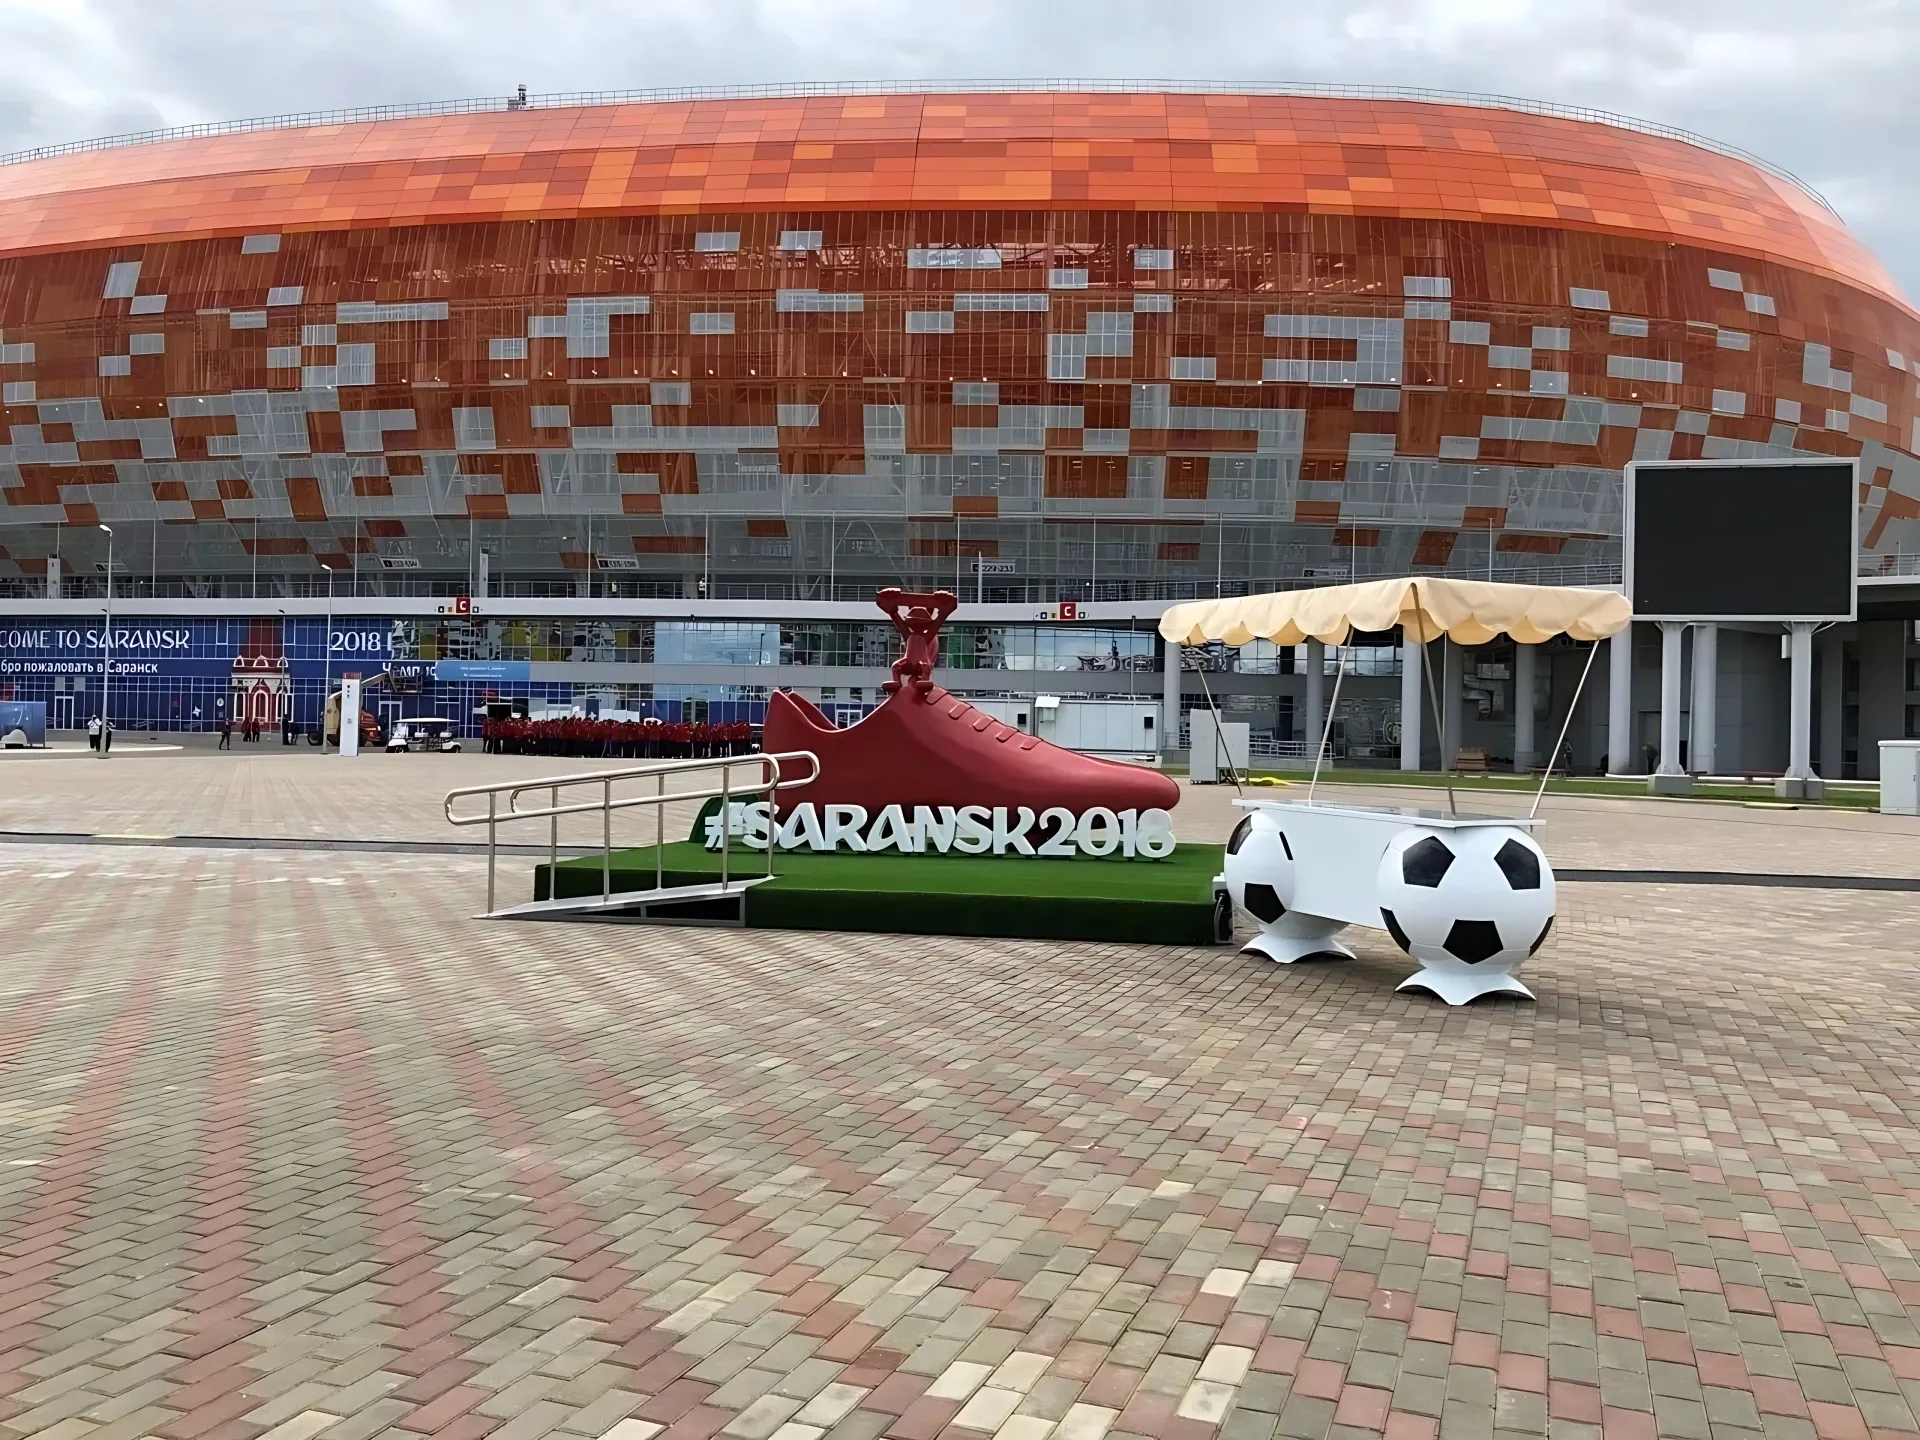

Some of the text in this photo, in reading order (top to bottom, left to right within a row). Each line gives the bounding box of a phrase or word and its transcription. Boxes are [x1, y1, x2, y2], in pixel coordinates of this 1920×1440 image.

[56, 629, 81, 649] TO
[86, 629, 190, 649] SARANSK
[329, 631, 381, 651] 2018
[24, 662, 94, 674] пожаловать
[107, 660, 158, 676] Саранск
[704, 801, 1177, 859] #SARANSK2018
